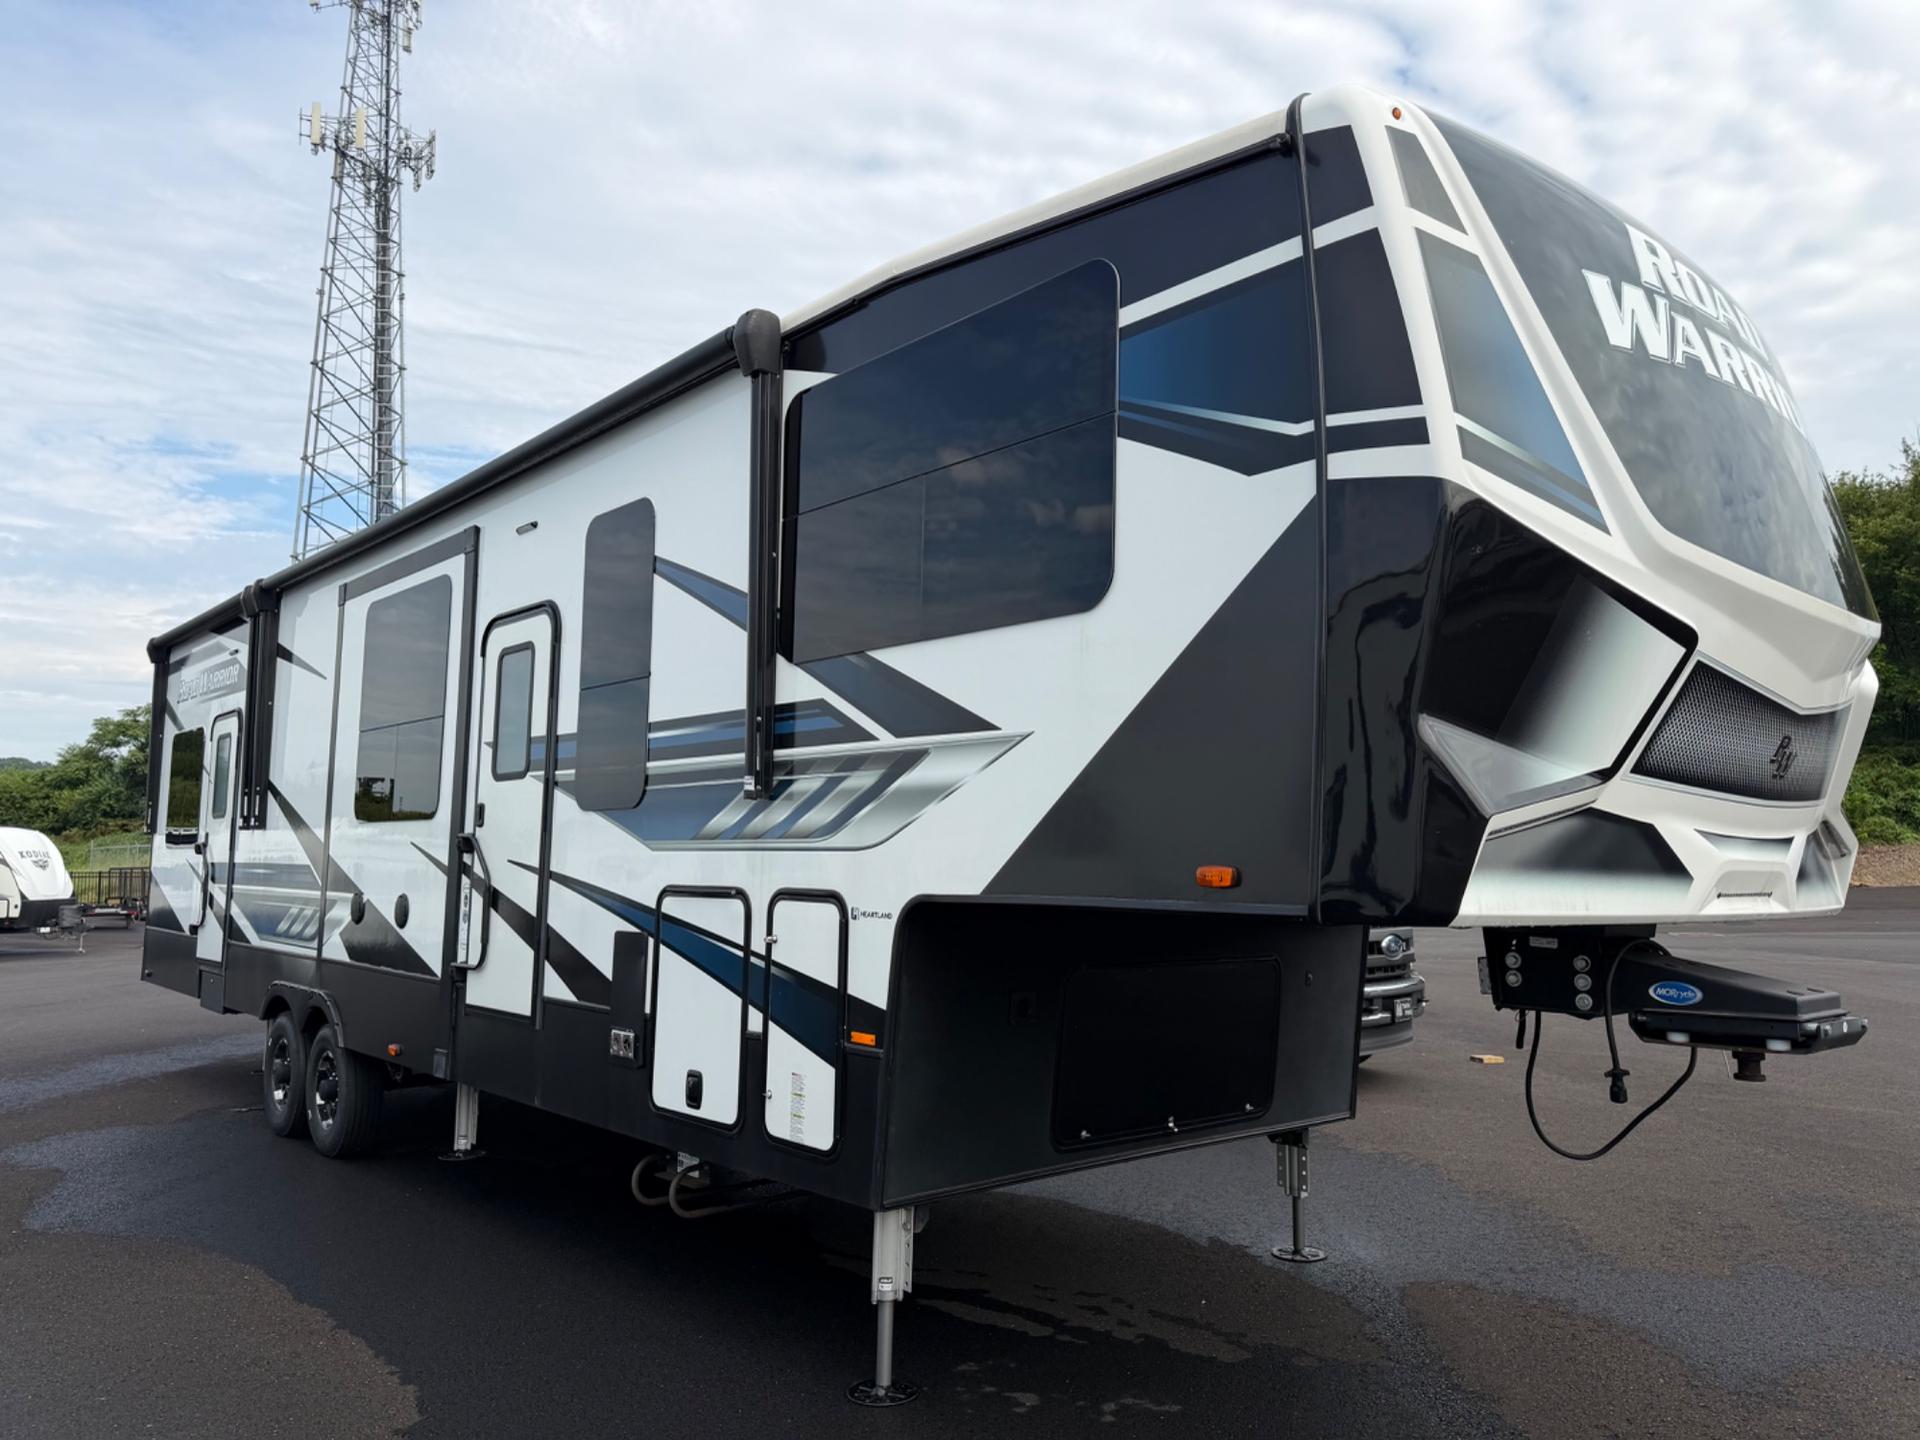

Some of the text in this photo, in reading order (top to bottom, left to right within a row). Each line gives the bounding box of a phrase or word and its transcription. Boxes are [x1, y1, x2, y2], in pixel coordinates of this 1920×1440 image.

[1581, 267, 1806, 439] WARRIO
[1624, 221, 1771, 366] ROAD
[860, 910, 893, 920] HEARTLAND
